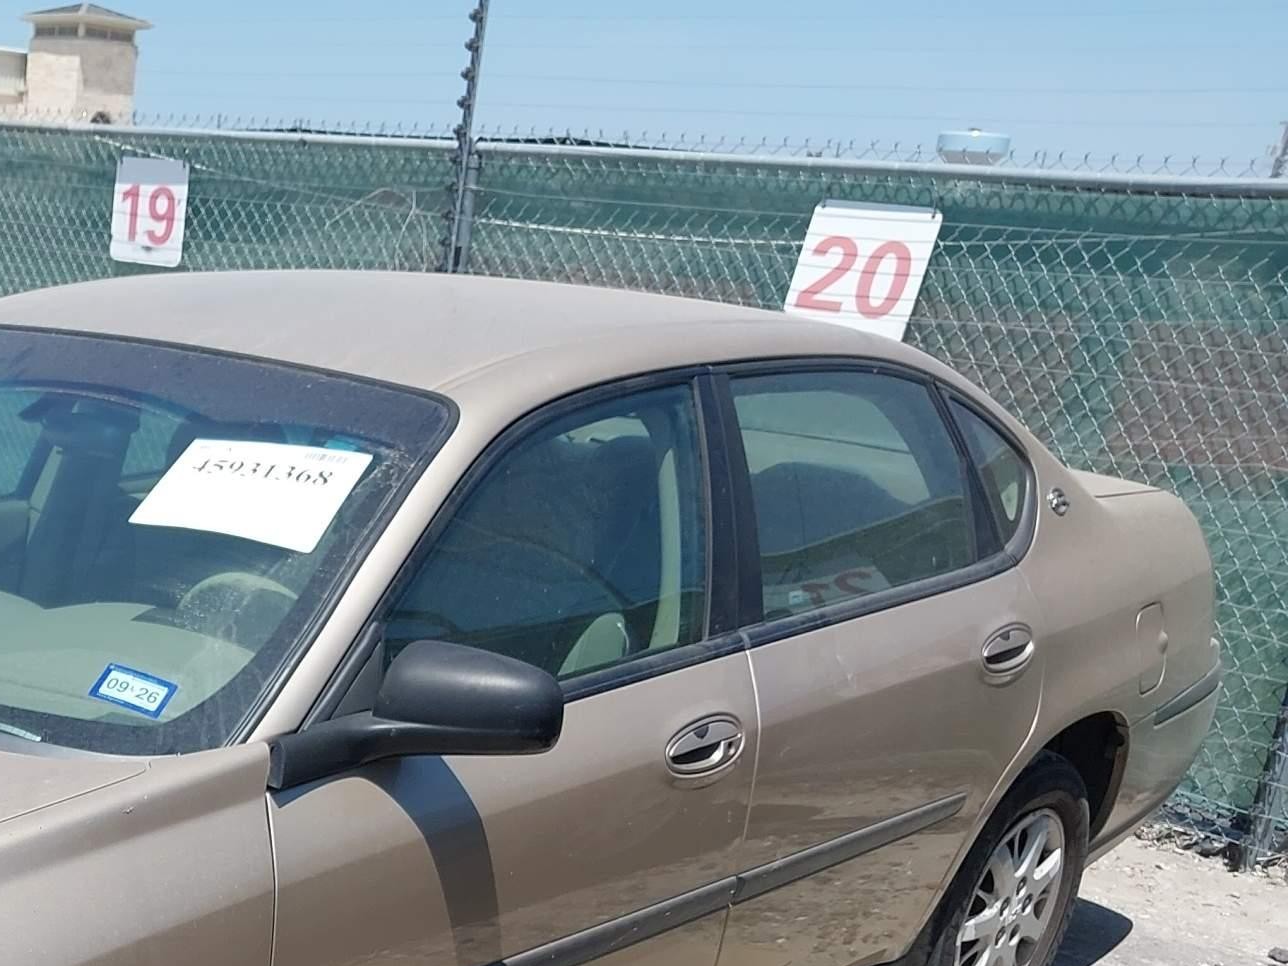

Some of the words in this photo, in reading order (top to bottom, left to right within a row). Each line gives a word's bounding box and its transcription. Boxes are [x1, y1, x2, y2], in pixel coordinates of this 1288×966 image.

[121, 184, 176, 246] 19
[794, 235, 912, 320] 20
[193, 458, 334, 486] 45931368
